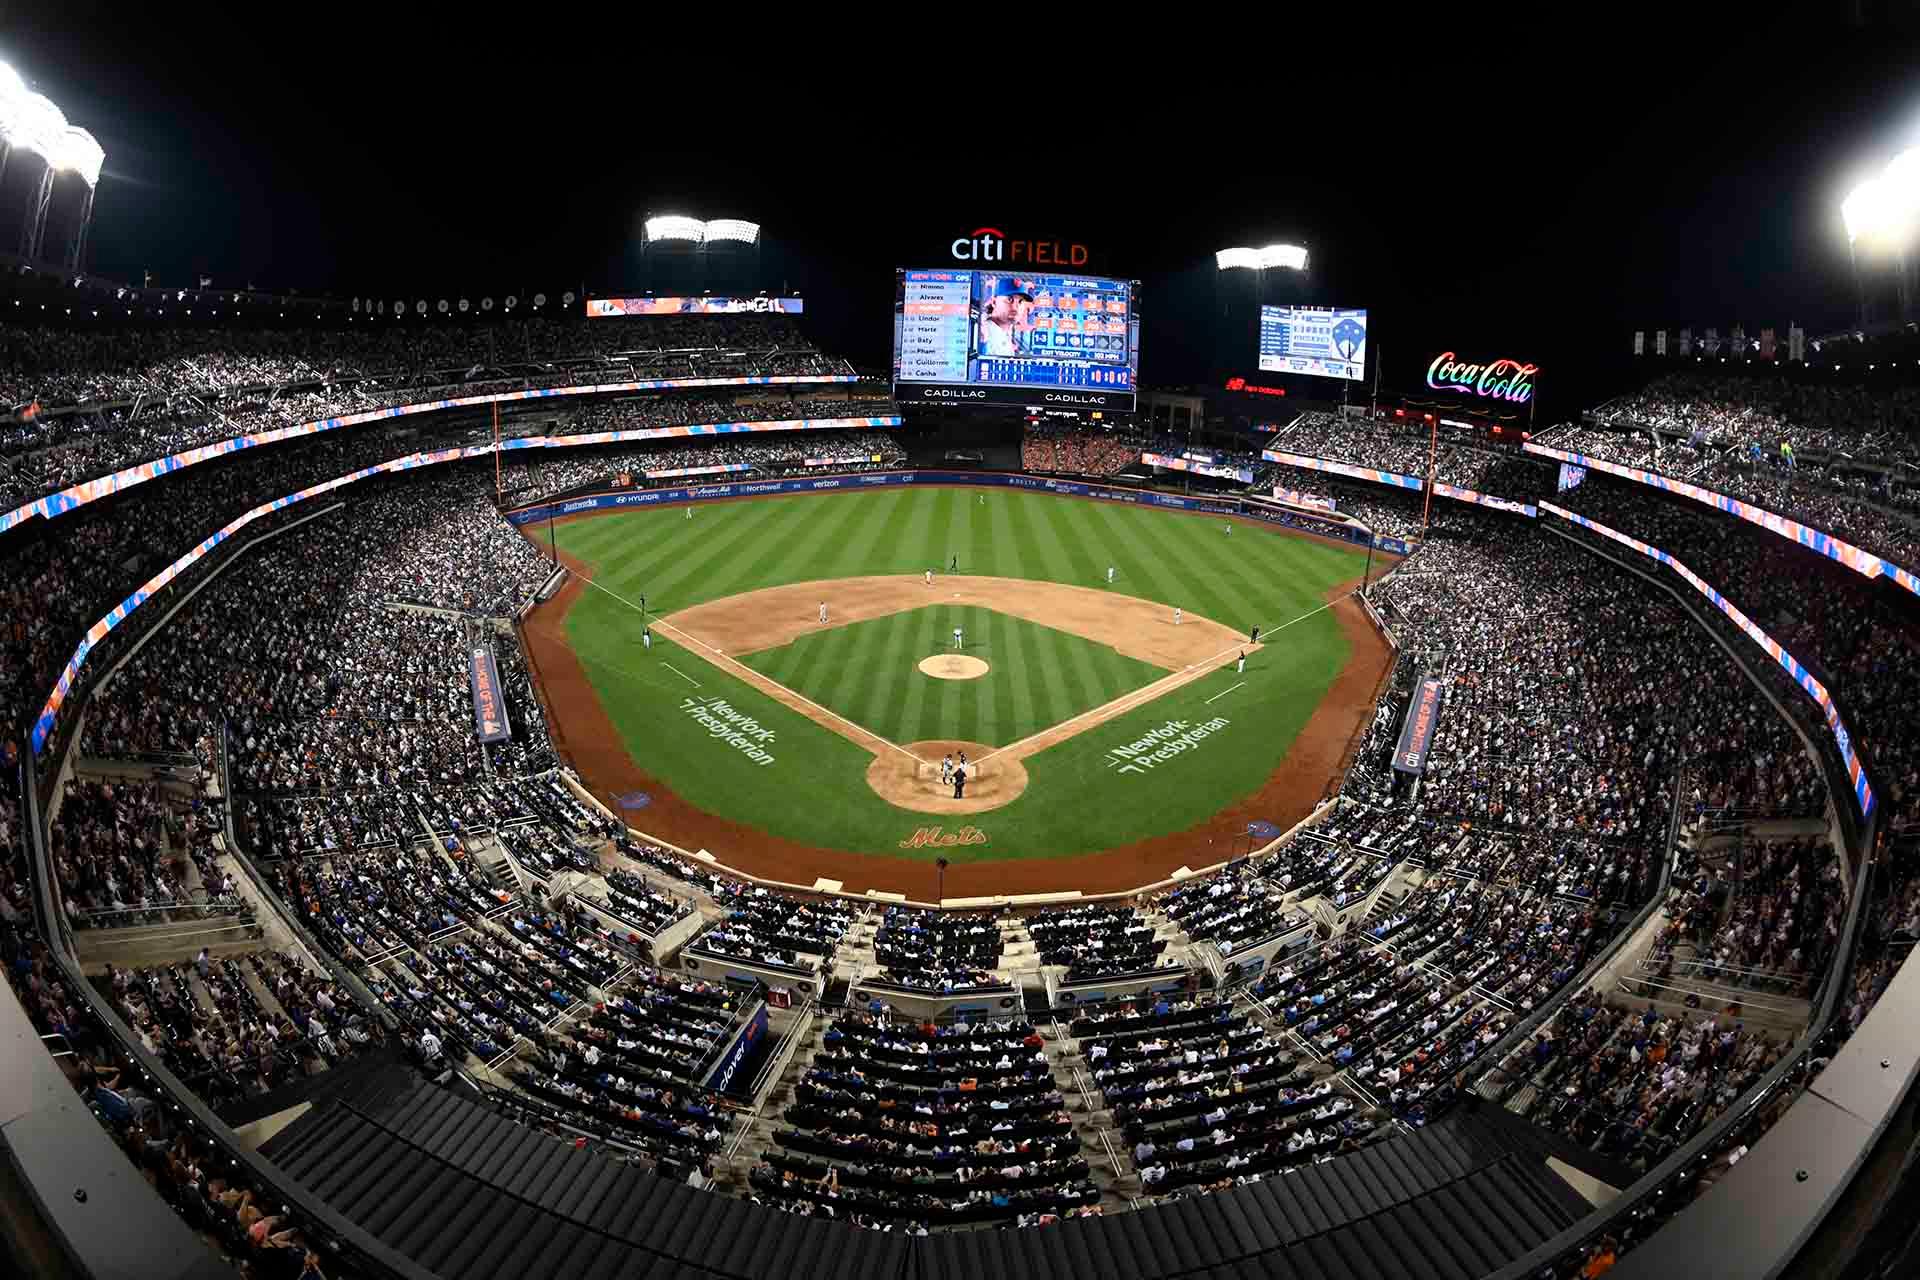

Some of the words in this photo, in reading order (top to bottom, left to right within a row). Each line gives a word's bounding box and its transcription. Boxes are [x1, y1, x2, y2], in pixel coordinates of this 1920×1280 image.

[951, 233, 1003, 261] citi
[1011, 240, 1088, 265] FIELD
[1427, 352, 1539, 403] Coca-Cola
[924, 389, 986, 398] CADILLAC
[1045, 393, 1106, 405] CADILLAC
[746, 483, 781, 492] Northwell
[812, 479, 839, 489] verizon
[563, 498, 597, 512] Justworks
[628, 494, 660, 503] HYUNDAI
[685, 706, 776, 766] Presbyterian
[1133, 717, 1230, 768] Presbyterian
[899, 826, 987, 849] Mets
[720, 1041, 745, 1092] clover
